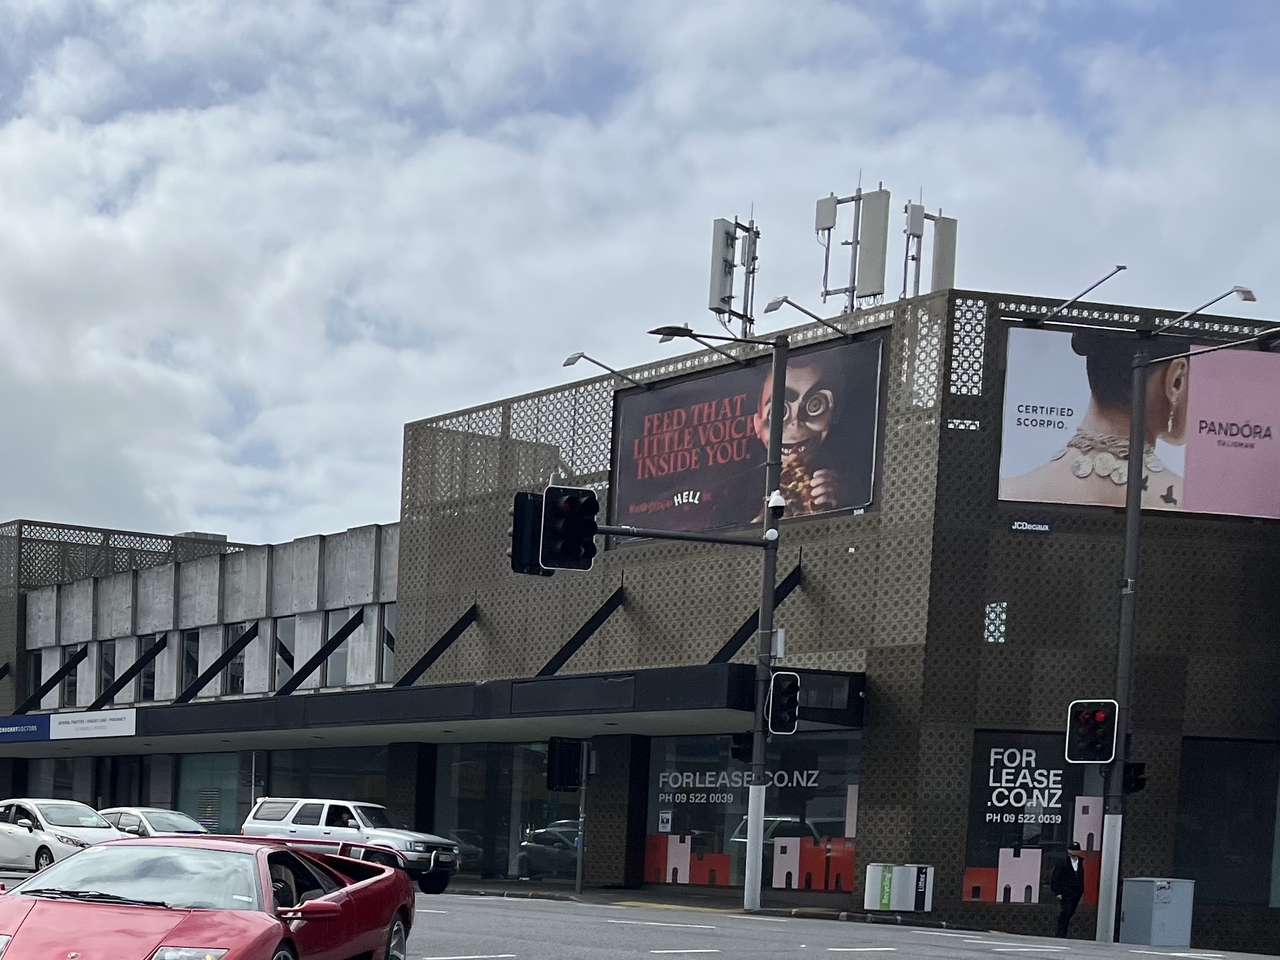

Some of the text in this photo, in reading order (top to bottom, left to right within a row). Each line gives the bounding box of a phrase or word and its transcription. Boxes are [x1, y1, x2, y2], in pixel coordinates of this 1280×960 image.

[643, 393, 748, 436] FEED THAT
[1017, 404, 1074, 417] CERTIFIED
[1016, 418, 1068, 430] SCORPIO.
[633, 414, 756, 459] LITTLE VOICE
[637, 439, 751, 480] INSIDE YOU.
[673, 490, 701, 507] HELL
[990, 748, 1037, 767] FOR
[989, 768, 1063, 788] LEASE
[658, 793, 734, 803] PH 09 522 0039
[985, 813, 1062, 824] PH 09 522 0039
[917, 874, 926, 892] Litter
